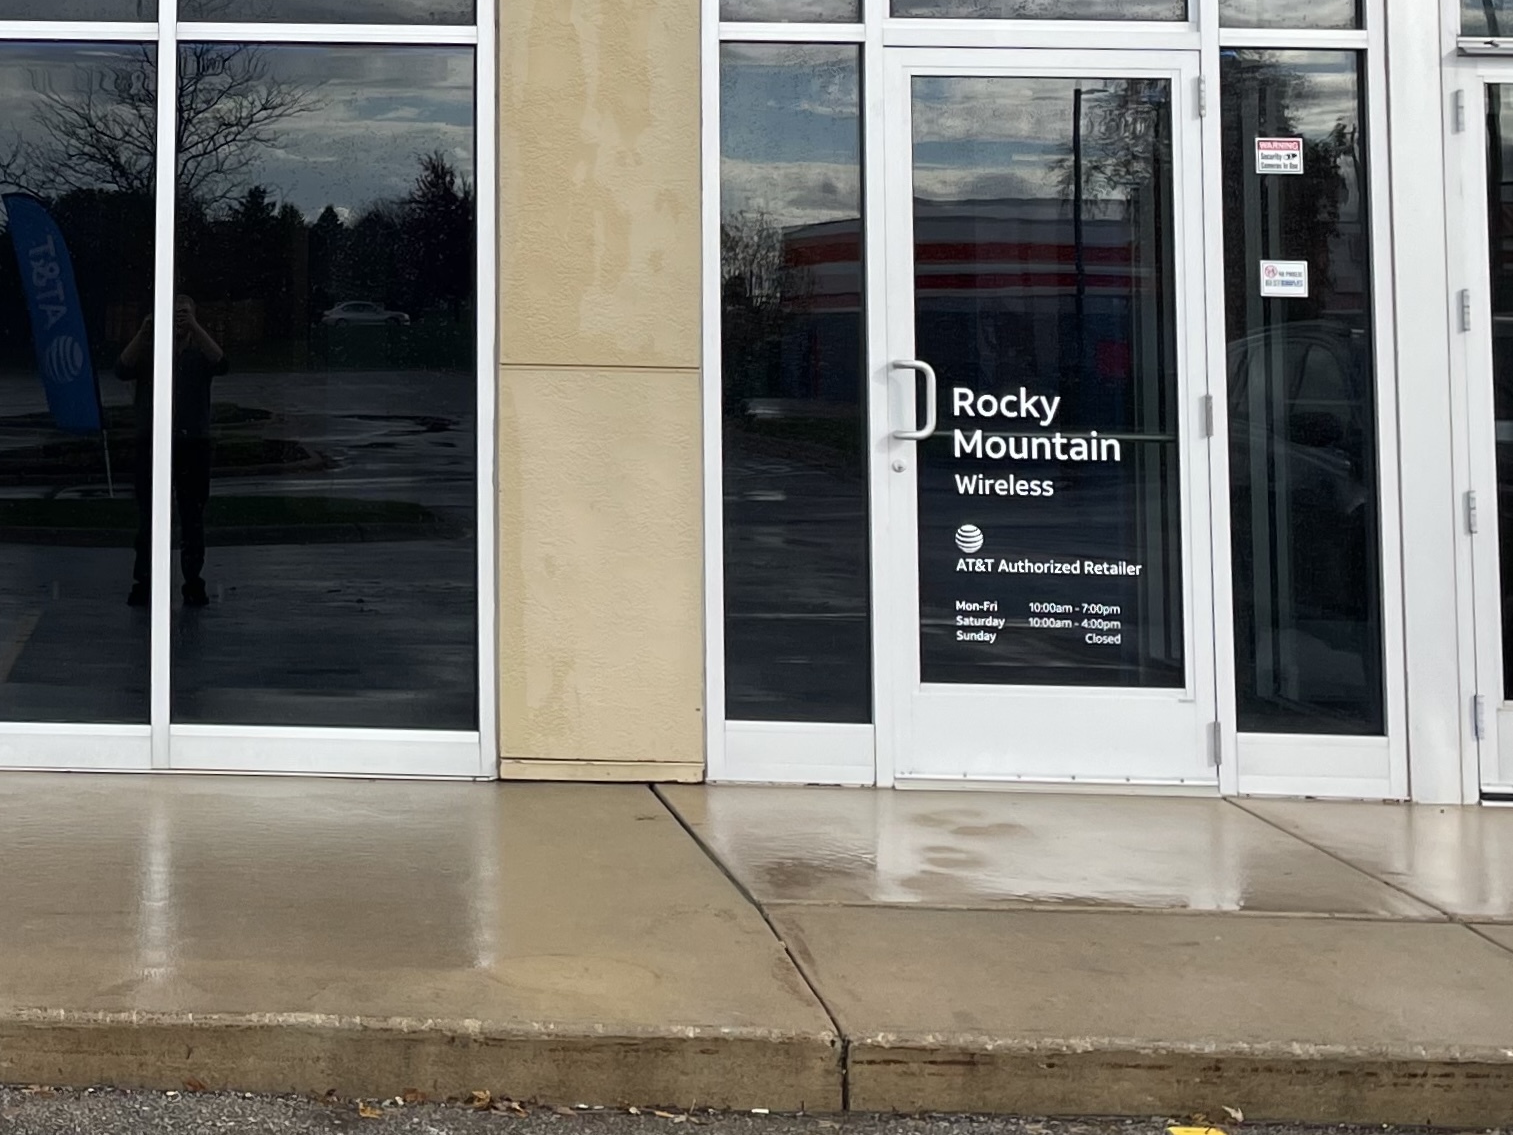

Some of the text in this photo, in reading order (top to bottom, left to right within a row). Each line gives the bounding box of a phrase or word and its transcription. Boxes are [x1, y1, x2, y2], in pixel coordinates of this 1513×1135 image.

[1259, 141, 1298, 150] WARNING
[953, 386, 1061, 426] Rocky
[953, 429, 1121, 461] Mountain
[955, 474, 1055, 496] Wireless
[956, 559, 1143, 576] AT&T Authorized Retailer
[955, 601, 998, 612] Mon-Fri
[1028, 602, 1073, 614] 10:00am
[1082, 603, 1121, 616] 7:00pm
[956, 616, 1005, 629] Saturday
[1028, 617, 1073, 628] 10:00am
[1081, 618, 1121, 631] 4:00pm
[956, 630, 1121, 644] Sunday Closed
